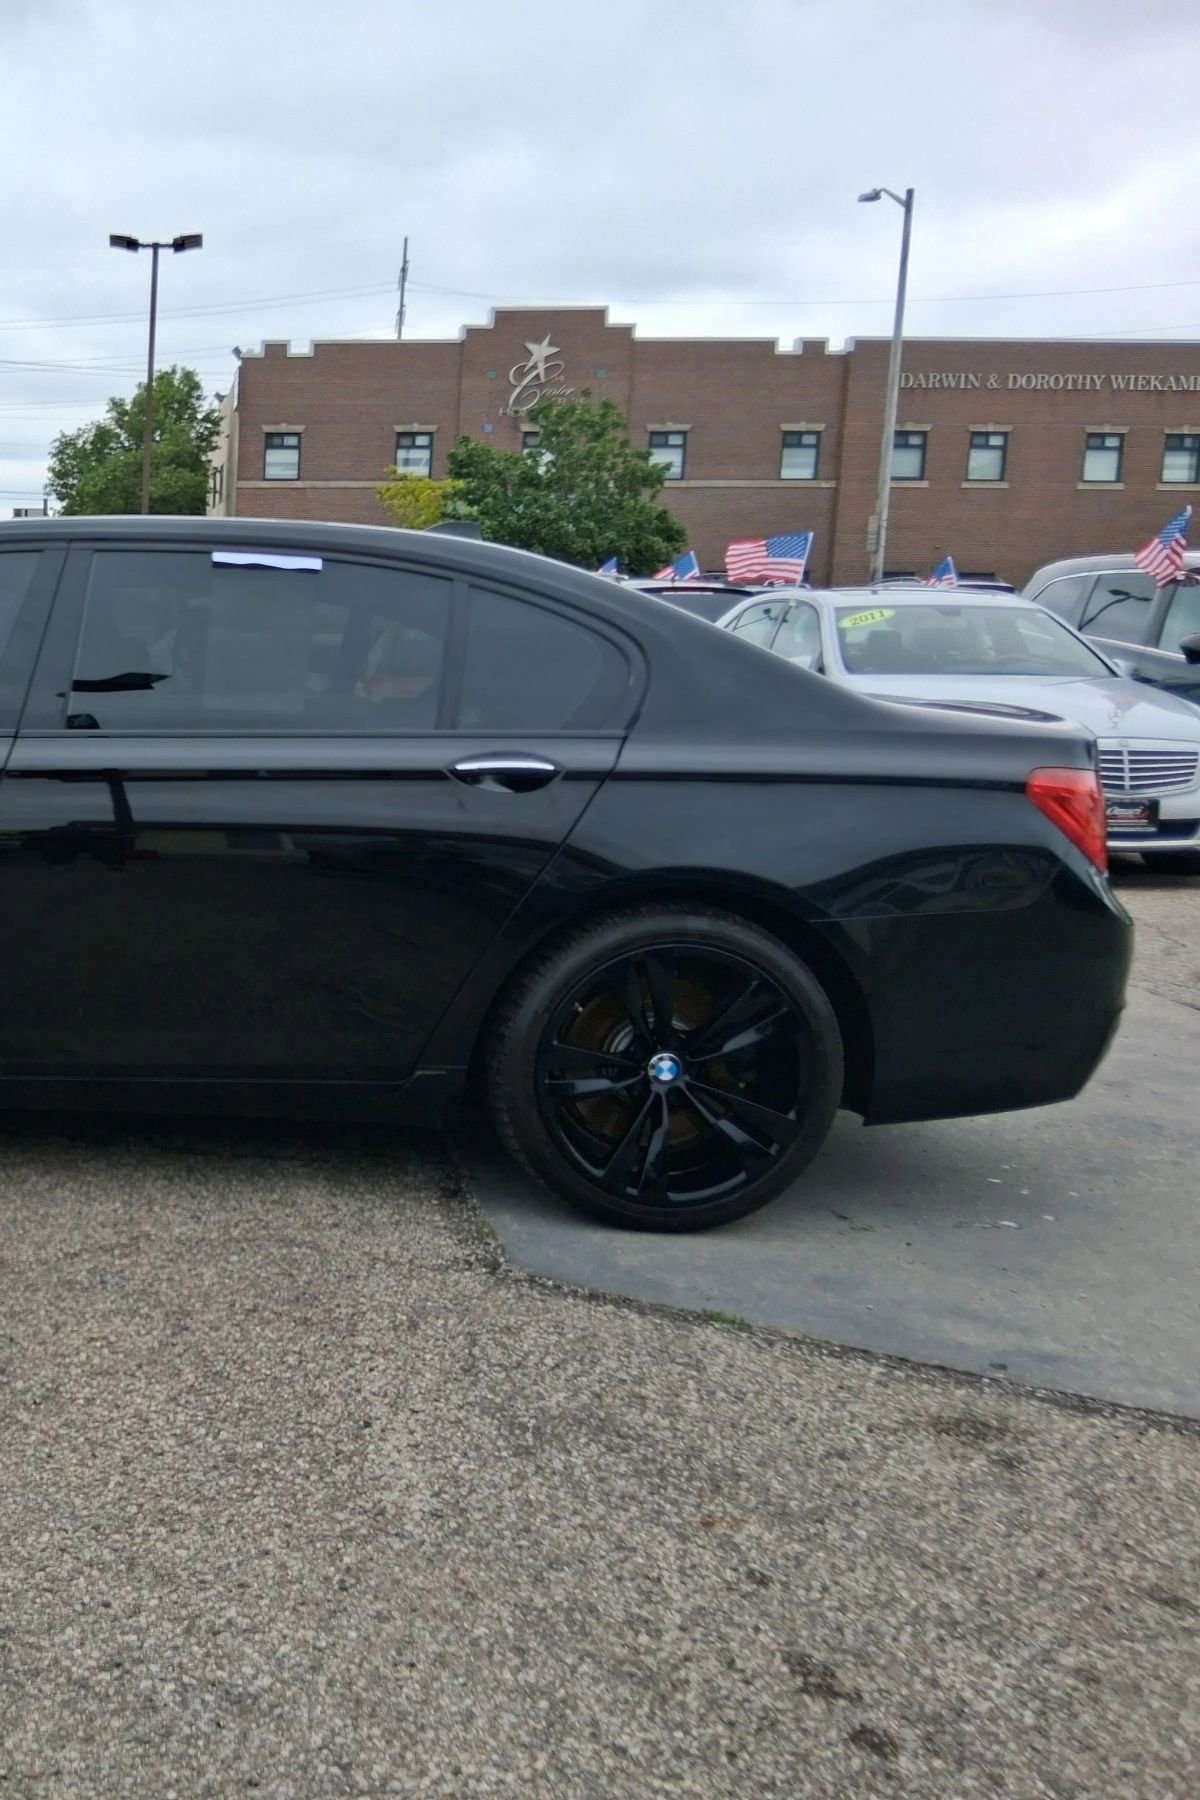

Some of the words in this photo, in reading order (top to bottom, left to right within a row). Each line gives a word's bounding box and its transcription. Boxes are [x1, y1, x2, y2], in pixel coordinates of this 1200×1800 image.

[900, 372, 982, 389] DARWIN
[986, 373, 1001, 390] &
[1008, 373, 1106, 390] DOROTHY
[850, 610, 885, 626] 2011
